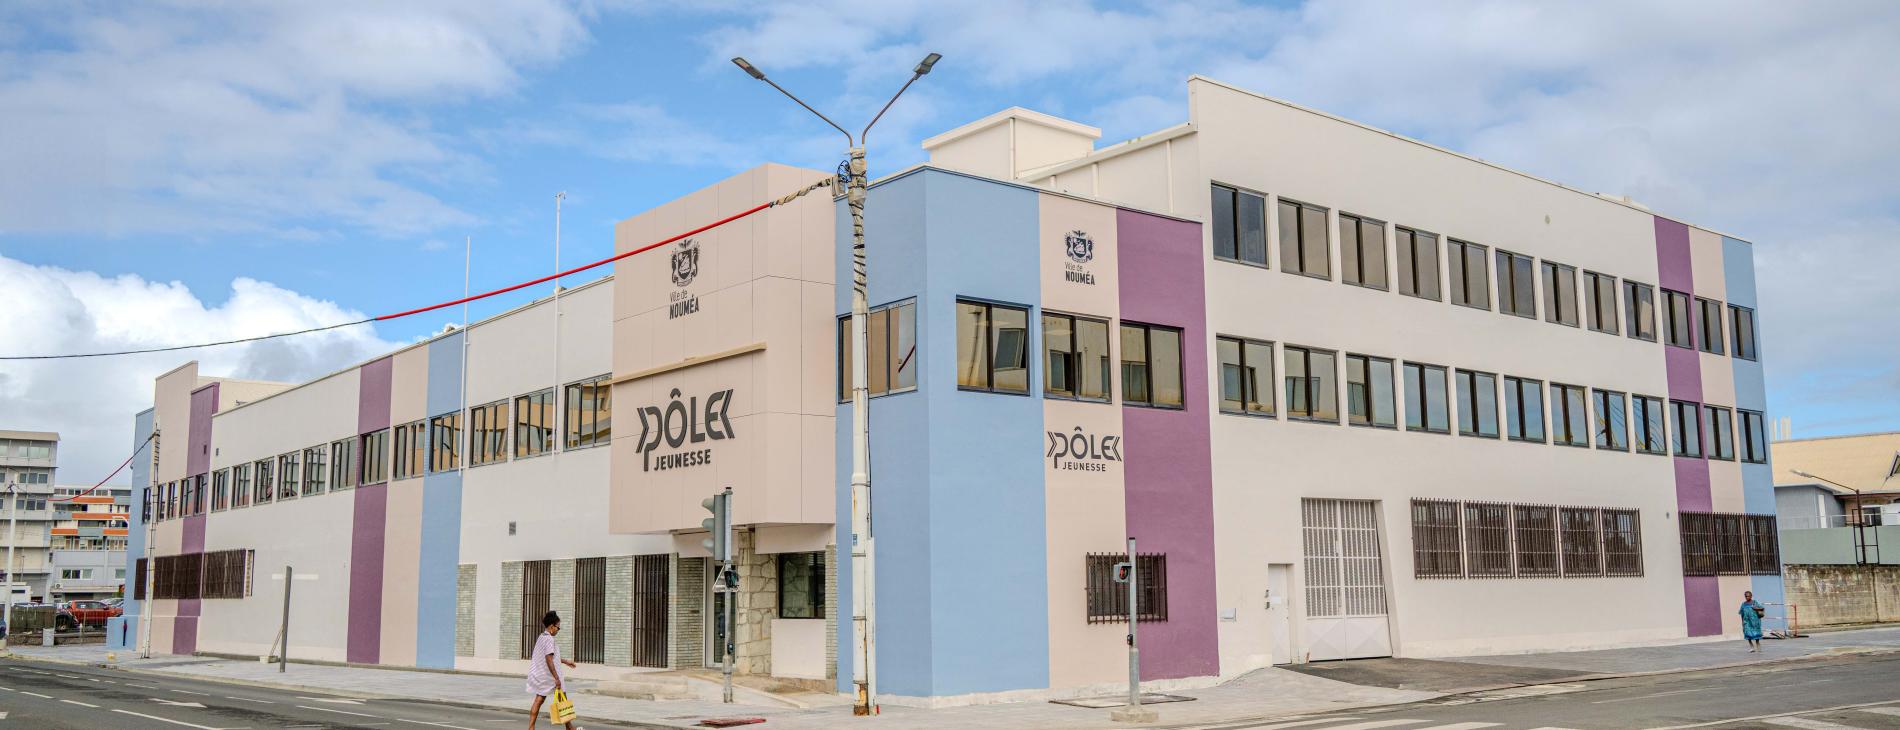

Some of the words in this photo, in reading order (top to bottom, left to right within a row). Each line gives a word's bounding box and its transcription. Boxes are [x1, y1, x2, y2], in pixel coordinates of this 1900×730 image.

[1065, 270, 1095, 285] NOUMÉA
[669, 291, 680, 303] Ville
[681, 289, 688, 299] de
[669, 293, 699, 320] NOUMÉA
[638, 388, 733, 472] PÔLE
[1048, 426, 1120, 469] PÔLE
[653, 448, 711, 471] JEUNESSE
[1062, 462, 1106, 472] JEUNESSE
